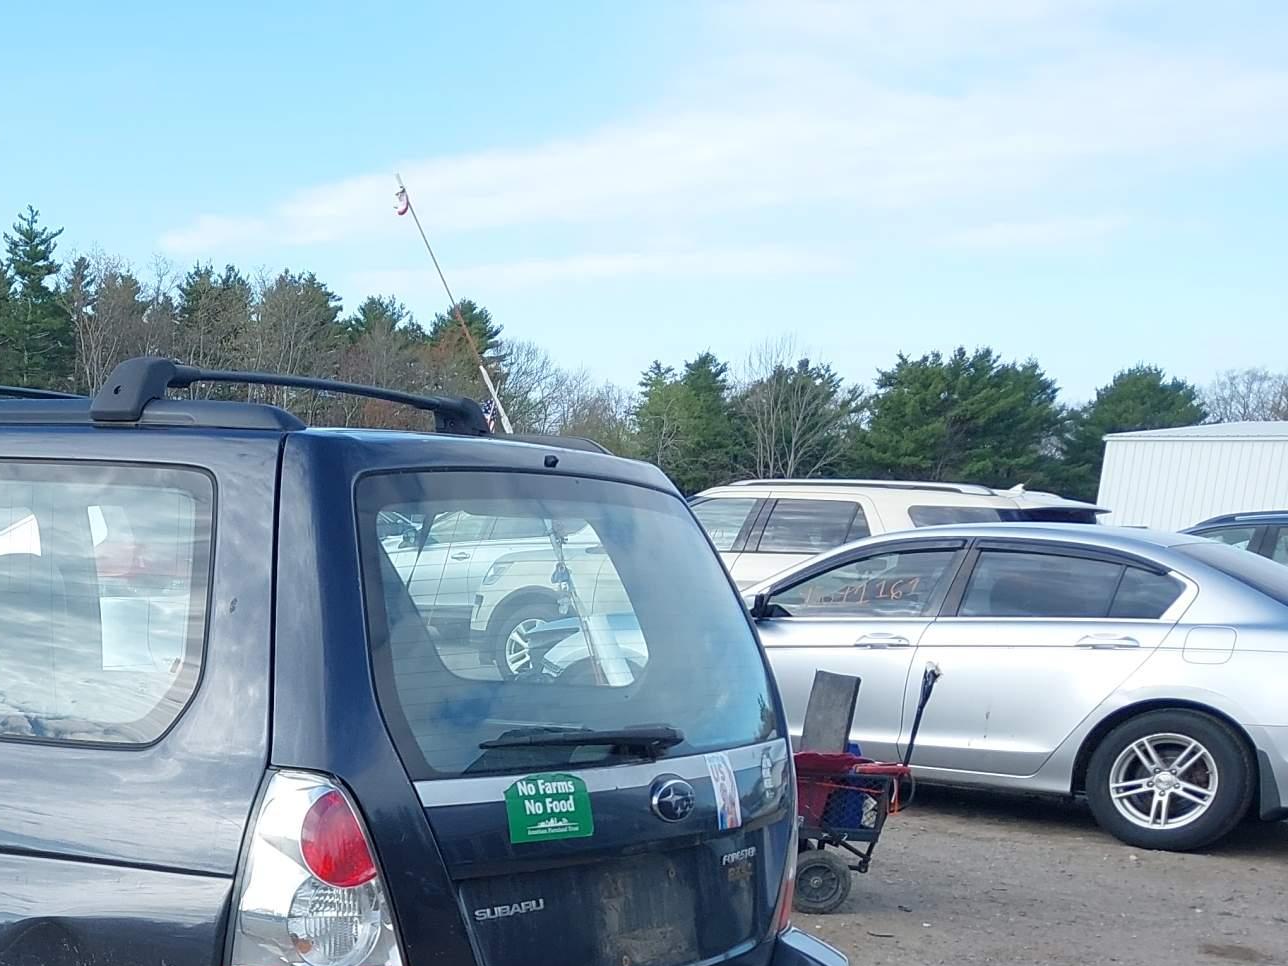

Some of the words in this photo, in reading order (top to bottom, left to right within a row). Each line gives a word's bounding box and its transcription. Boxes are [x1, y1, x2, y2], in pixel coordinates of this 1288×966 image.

[516, 780, 536, 796] No
[537, 779, 575, 795] Farms
[524, 799, 543, 815] No
[545, 795, 576, 813] Food
[474, 898, 544, 920] SUBARU
